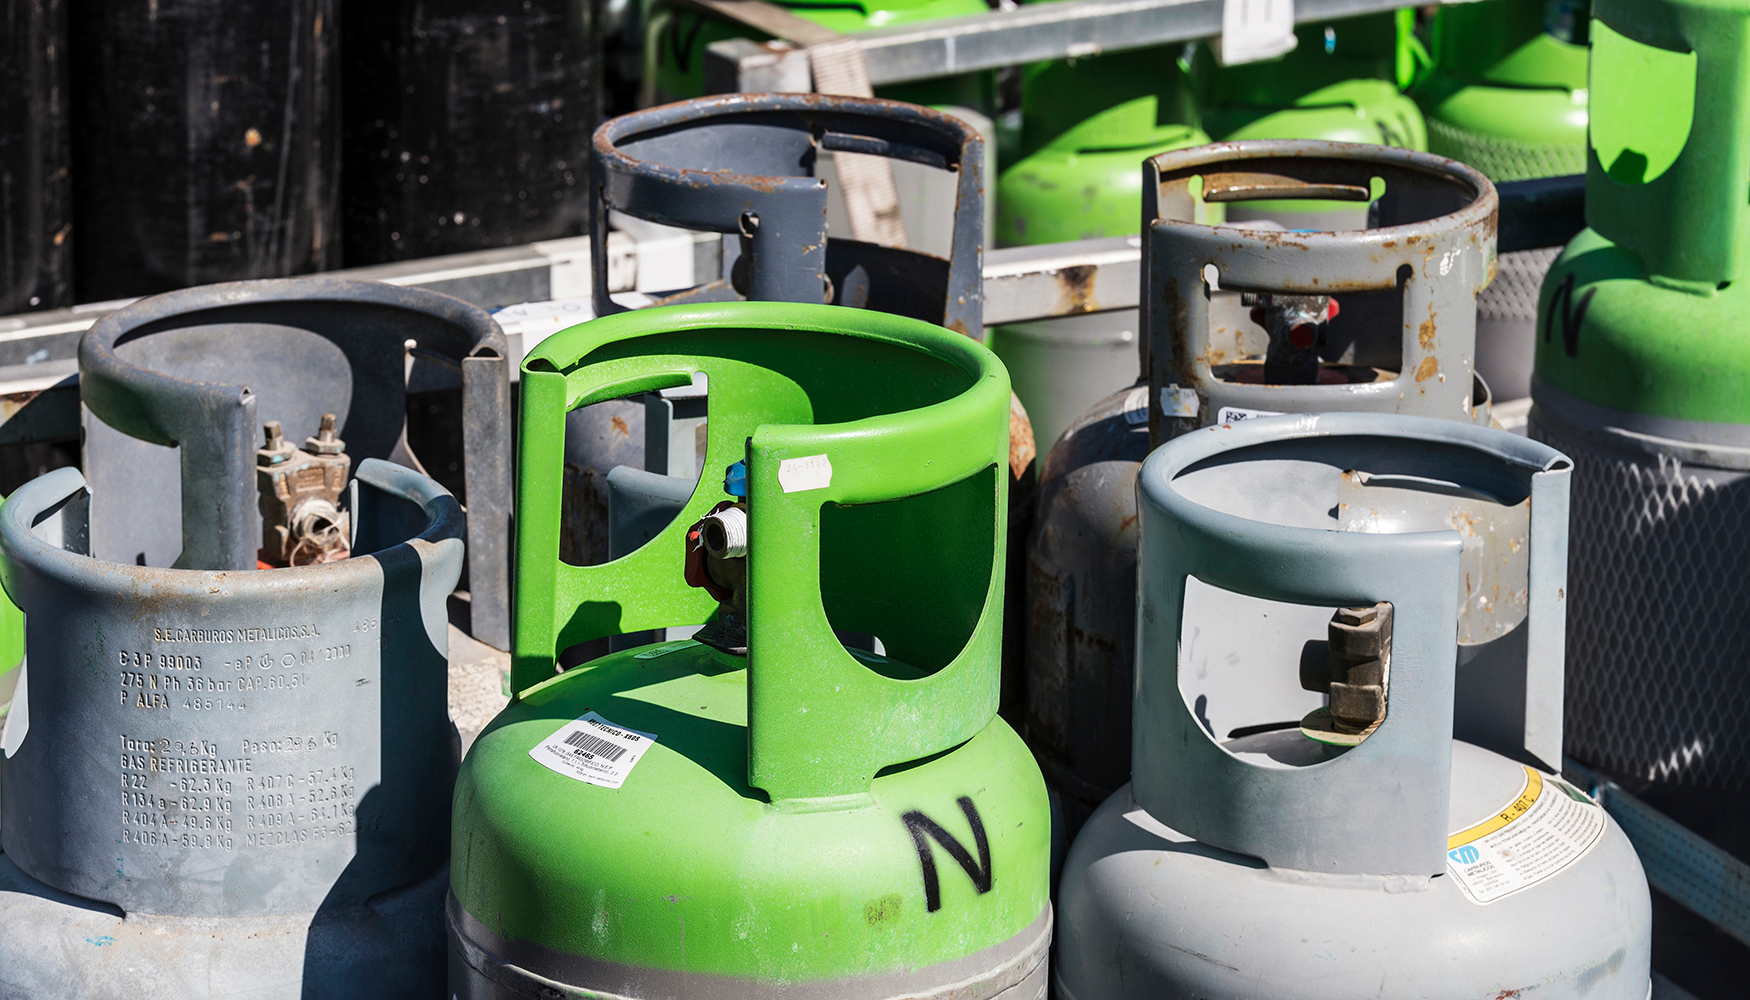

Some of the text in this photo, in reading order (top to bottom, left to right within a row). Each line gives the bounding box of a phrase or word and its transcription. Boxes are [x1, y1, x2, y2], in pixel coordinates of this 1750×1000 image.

[1545, 272, 1598, 358] N
[159, 654, 202, 671] 99003
[120, 671, 144, 689] 275
[149, 674, 158, 690] N
[163, 675, 181, 691] Ph
[186, 676, 204, 692] 36
[120, 690, 247, 711] P ALFA 485144
[120, 734, 156, 754] Tara:
[323, 731, 339, 749] Kg
[120, 754, 252, 774] GAS REFRIGERANTE
[573, 748, 595, 760] 62465
[215, 777, 232, 797] Kg
[215, 796, 232, 815] Kg
[1500, 813, 1514, 823] R
[1513, 799, 1529, 813] 407
[1523, 794, 1535, 804] C
[216, 815, 233, 834] Kg
[216, 834, 233, 853] Kg
[900, 796, 992, 913] N
